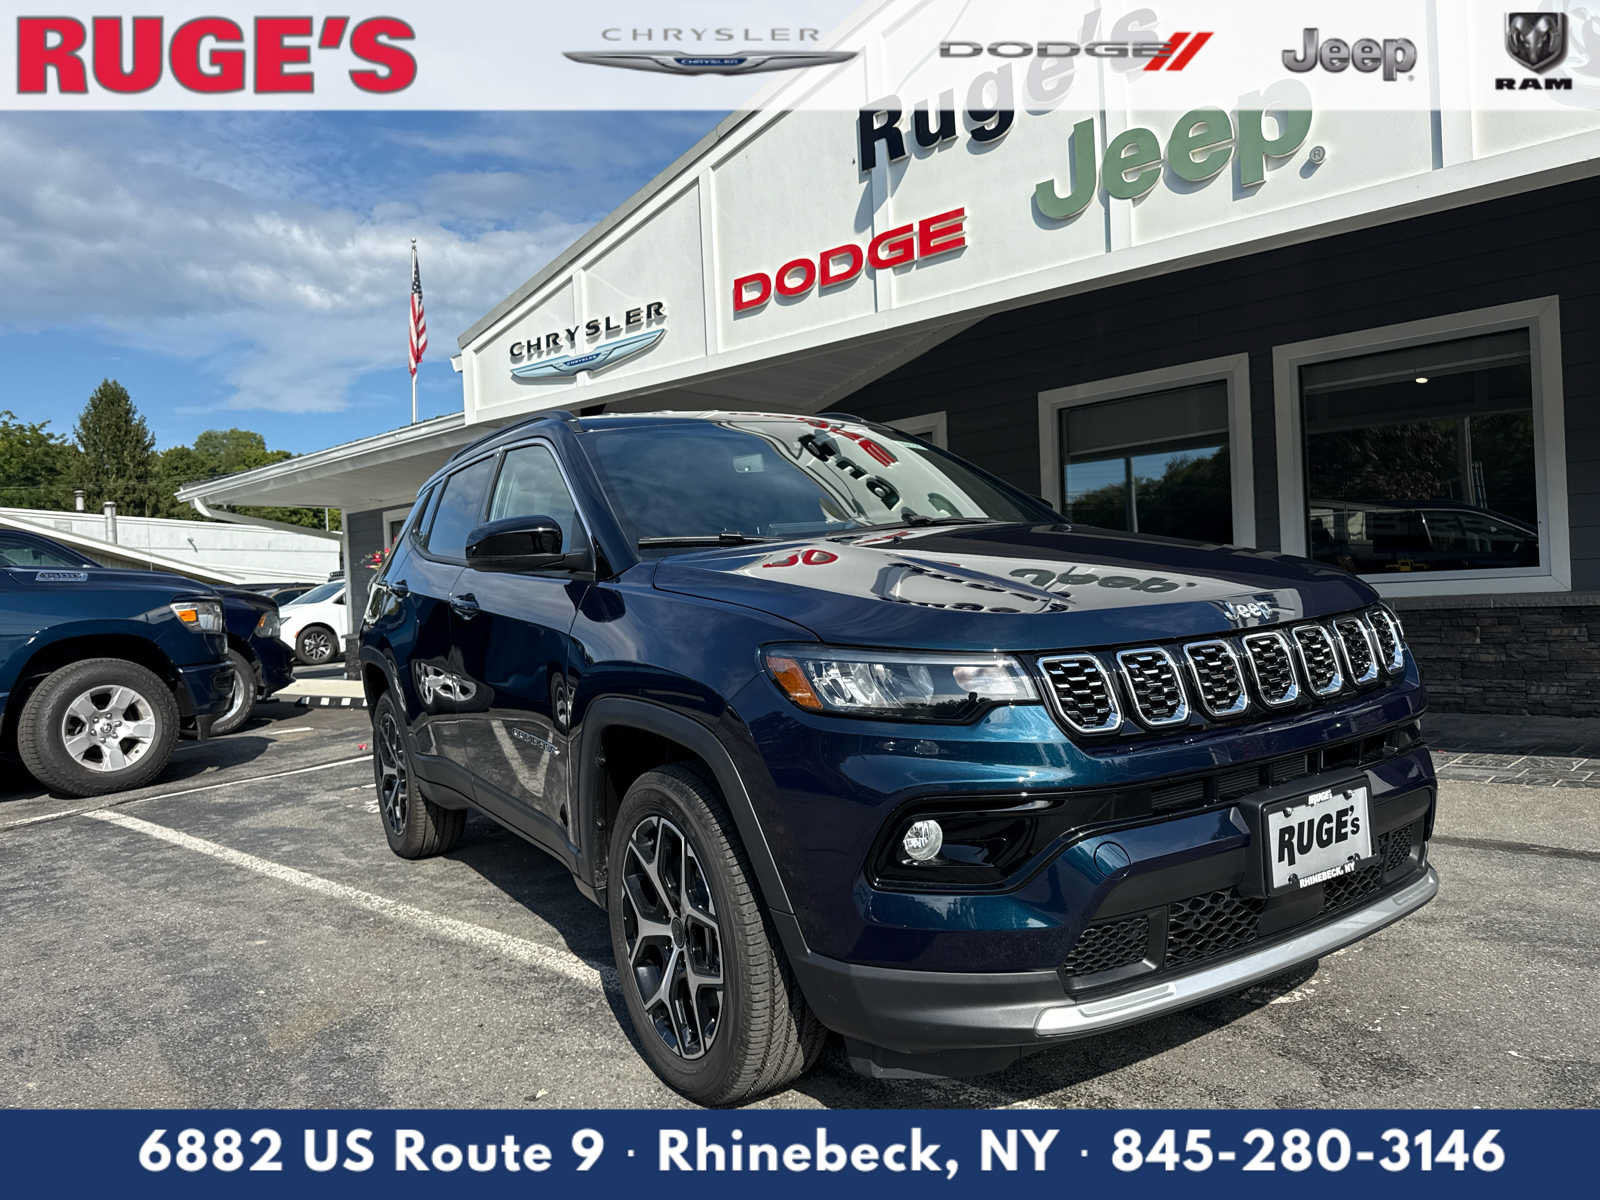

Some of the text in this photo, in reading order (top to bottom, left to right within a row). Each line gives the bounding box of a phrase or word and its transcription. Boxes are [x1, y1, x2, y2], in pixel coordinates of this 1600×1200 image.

[1034, 78, 1313, 220] Jeep
[732, 206, 967, 313] DODGE
[509, 301, 665, 357] CHRYSLER
[1224, 600, 1272, 620] Jeep
[1277, 804, 1360, 867] RUGE's
[1344, 861, 1355, 874] NY
